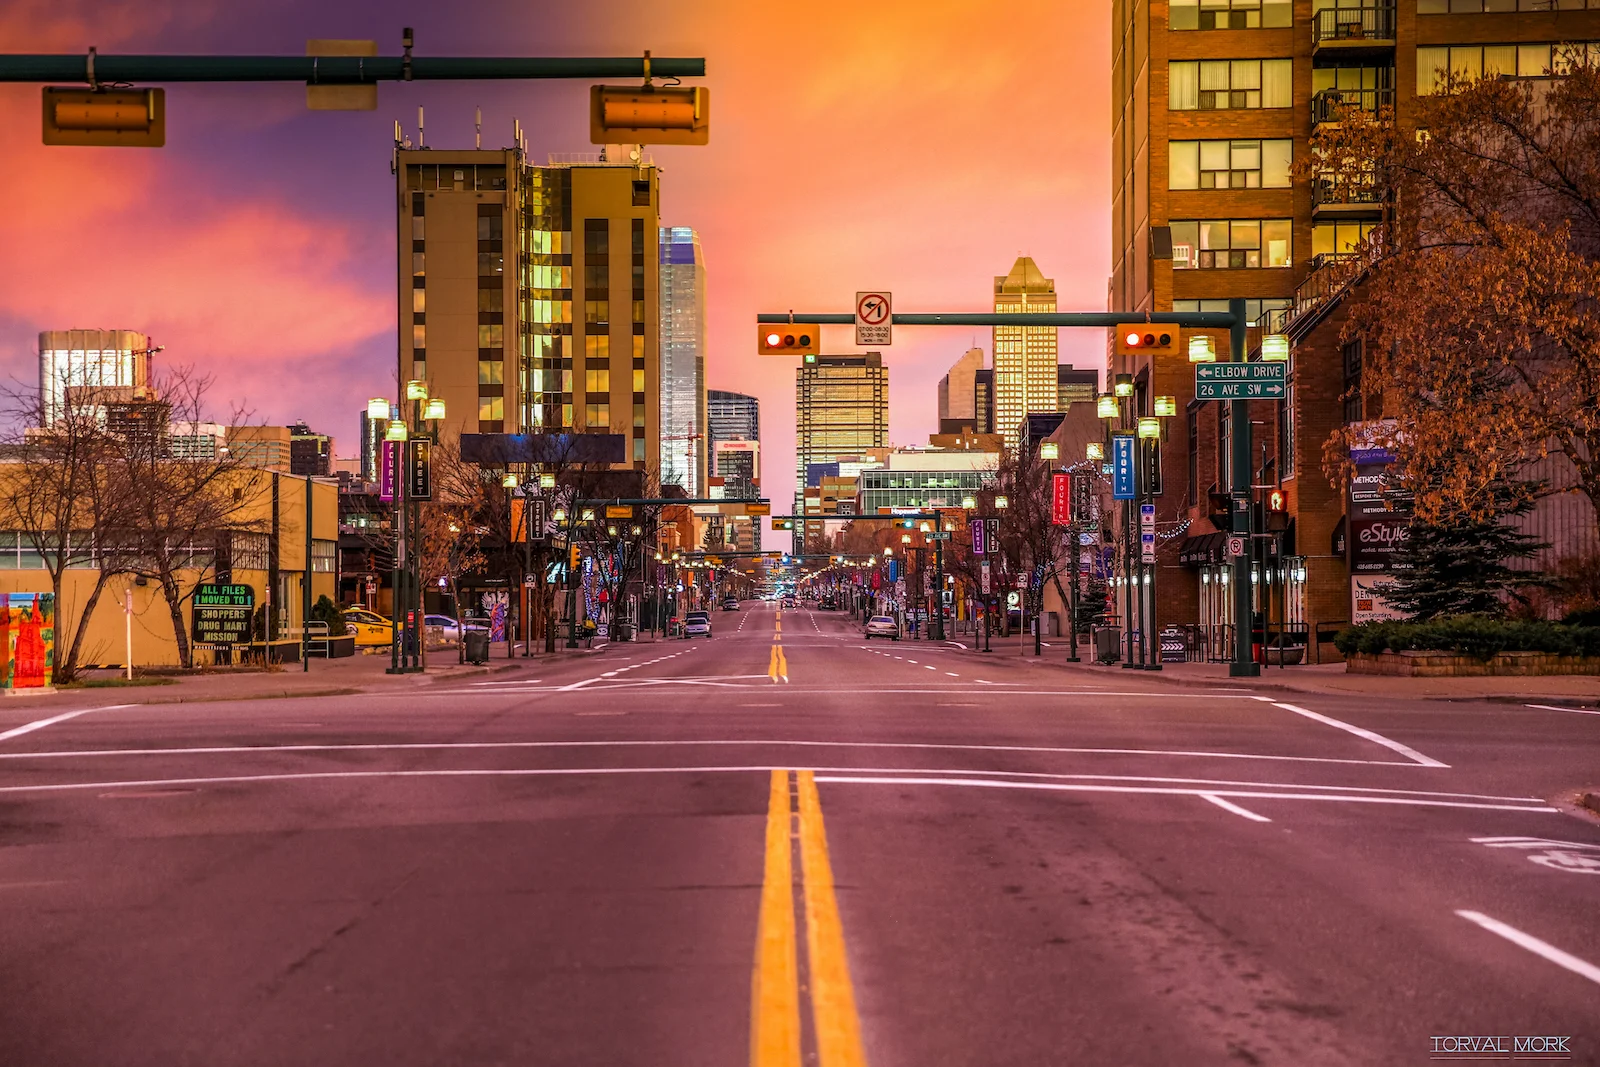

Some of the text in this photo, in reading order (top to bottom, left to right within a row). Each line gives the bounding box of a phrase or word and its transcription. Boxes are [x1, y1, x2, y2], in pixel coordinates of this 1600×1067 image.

[1214, 366, 1281, 378] ELBOW DRIVE
[1200, 384, 1262, 396] 26 AVE SW
[201, 585, 246, 595] ALL FILES
[201, 595, 245, 605] MOVED TO
[201, 609, 246, 619] SHOPPERS
[197, 620, 248, 631] DRUG MART
[203, 632, 239, 642] MISSION
